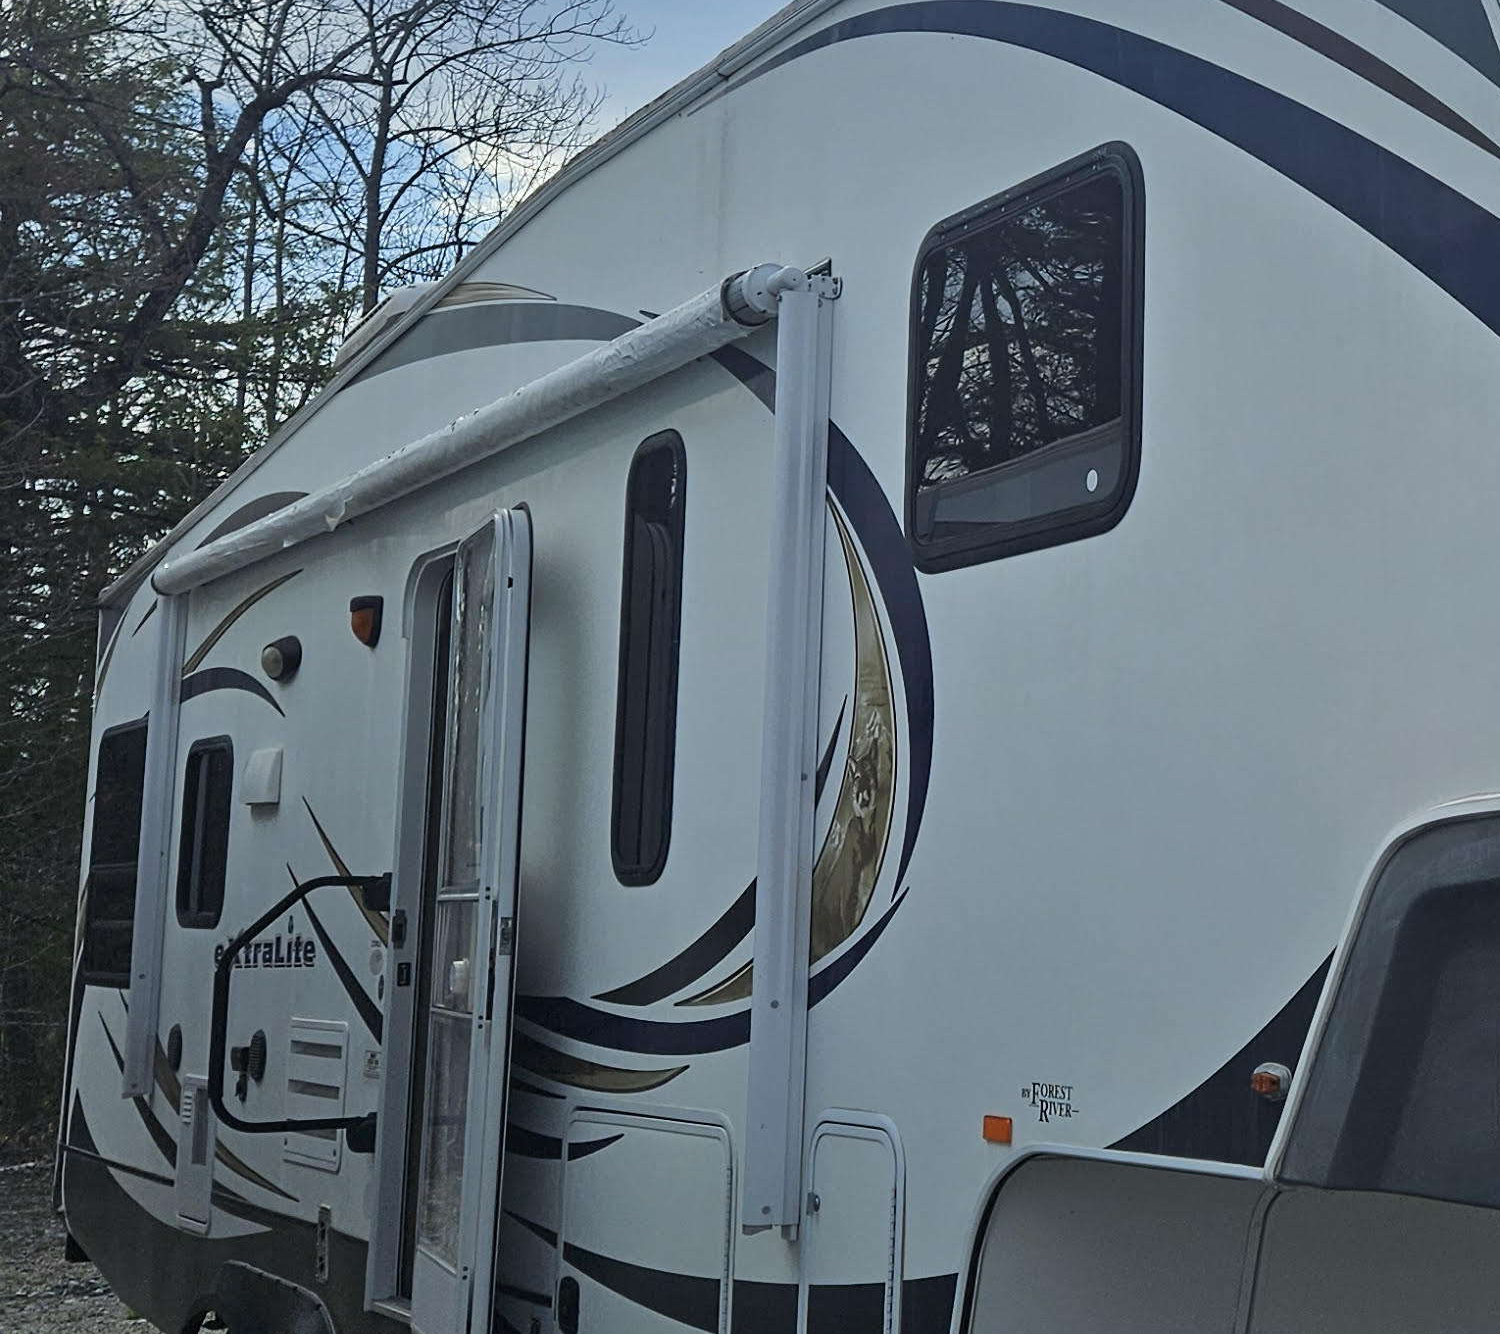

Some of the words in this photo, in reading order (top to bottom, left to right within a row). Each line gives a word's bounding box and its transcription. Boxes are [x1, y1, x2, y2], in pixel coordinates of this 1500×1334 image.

[1021, 1088, 1031, 1098] BY
[1032, 1082, 1073, 1104] FOREST
[1039, 1099, 1072, 1123] RIVER
